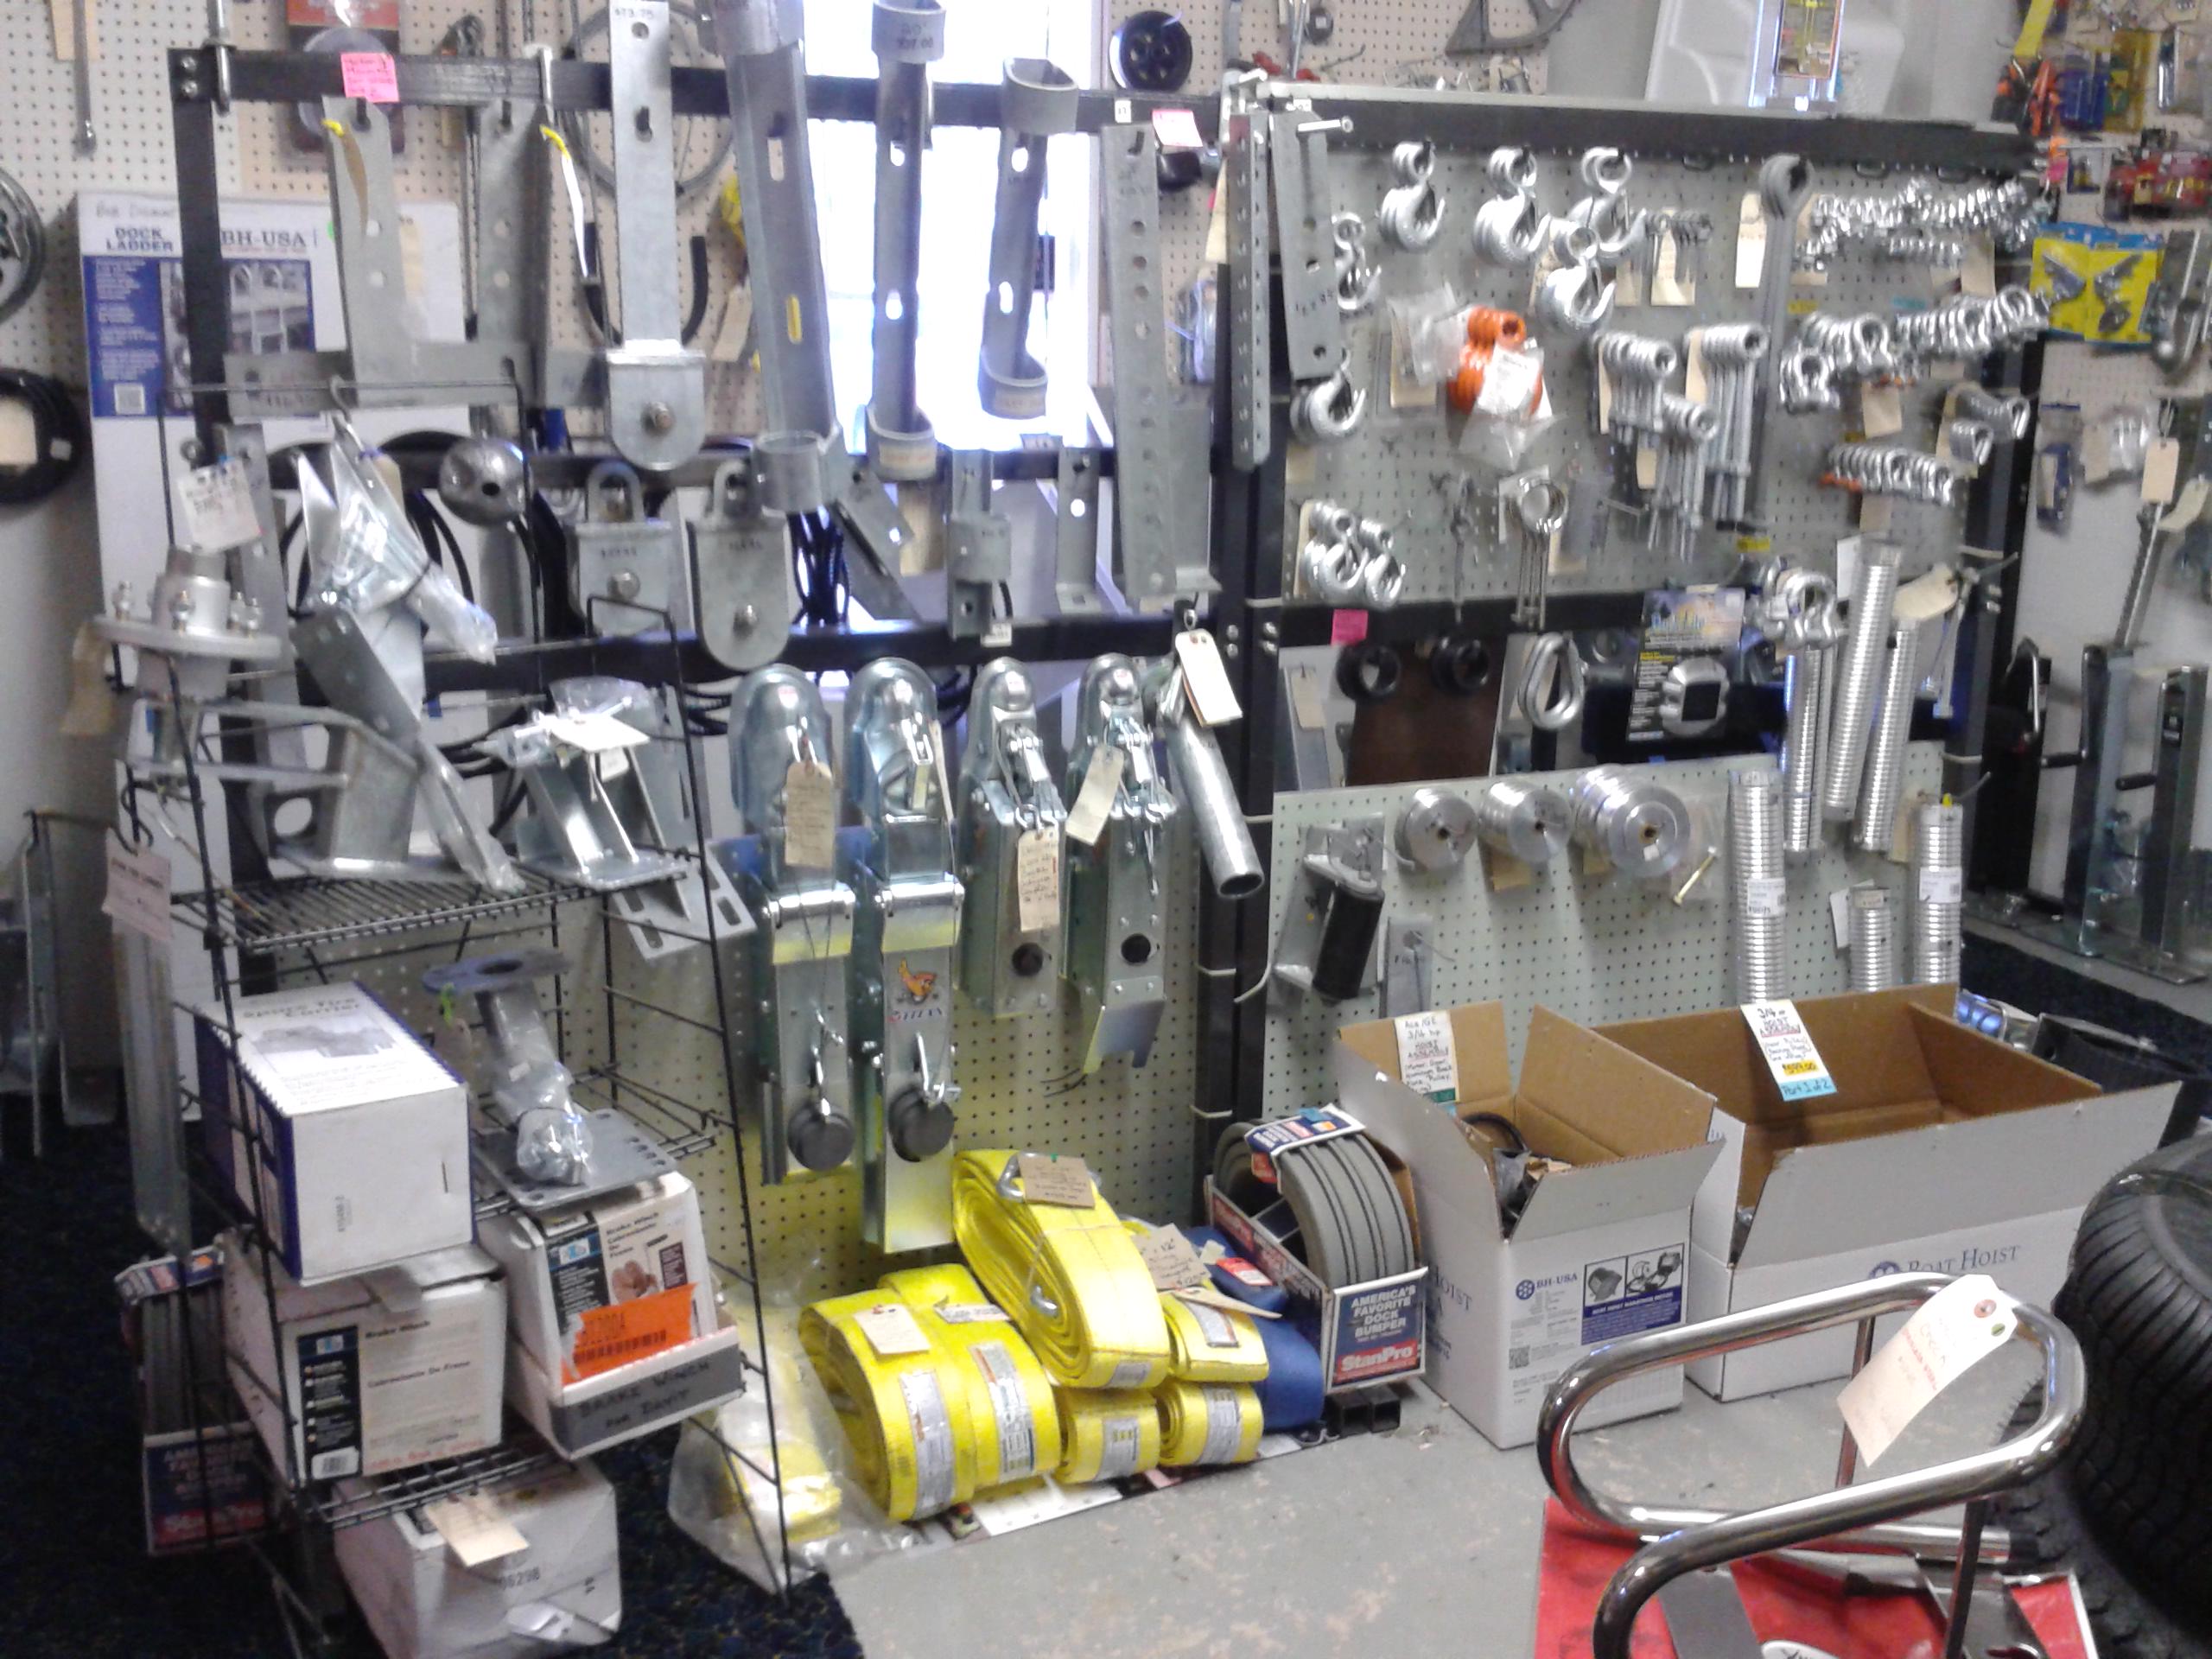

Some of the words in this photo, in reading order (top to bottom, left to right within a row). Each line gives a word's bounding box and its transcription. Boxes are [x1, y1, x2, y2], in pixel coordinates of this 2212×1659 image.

[115, 226, 162, 239] DOCK
[105, 239, 174, 251] LADDER
[1961, 1245, 2020, 1271] HOIST
[1536, 1272, 1578, 1289] BH-USA
[1351, 1284, 1416, 1308] AMERICA'S
[1353, 1296, 1412, 1318] FAVORITE
[1364, 1309, 1399, 1325] DOCK
[1355, 1317, 1407, 1338] BUMPER
[1341, 1345, 1414, 1372] StanPro
